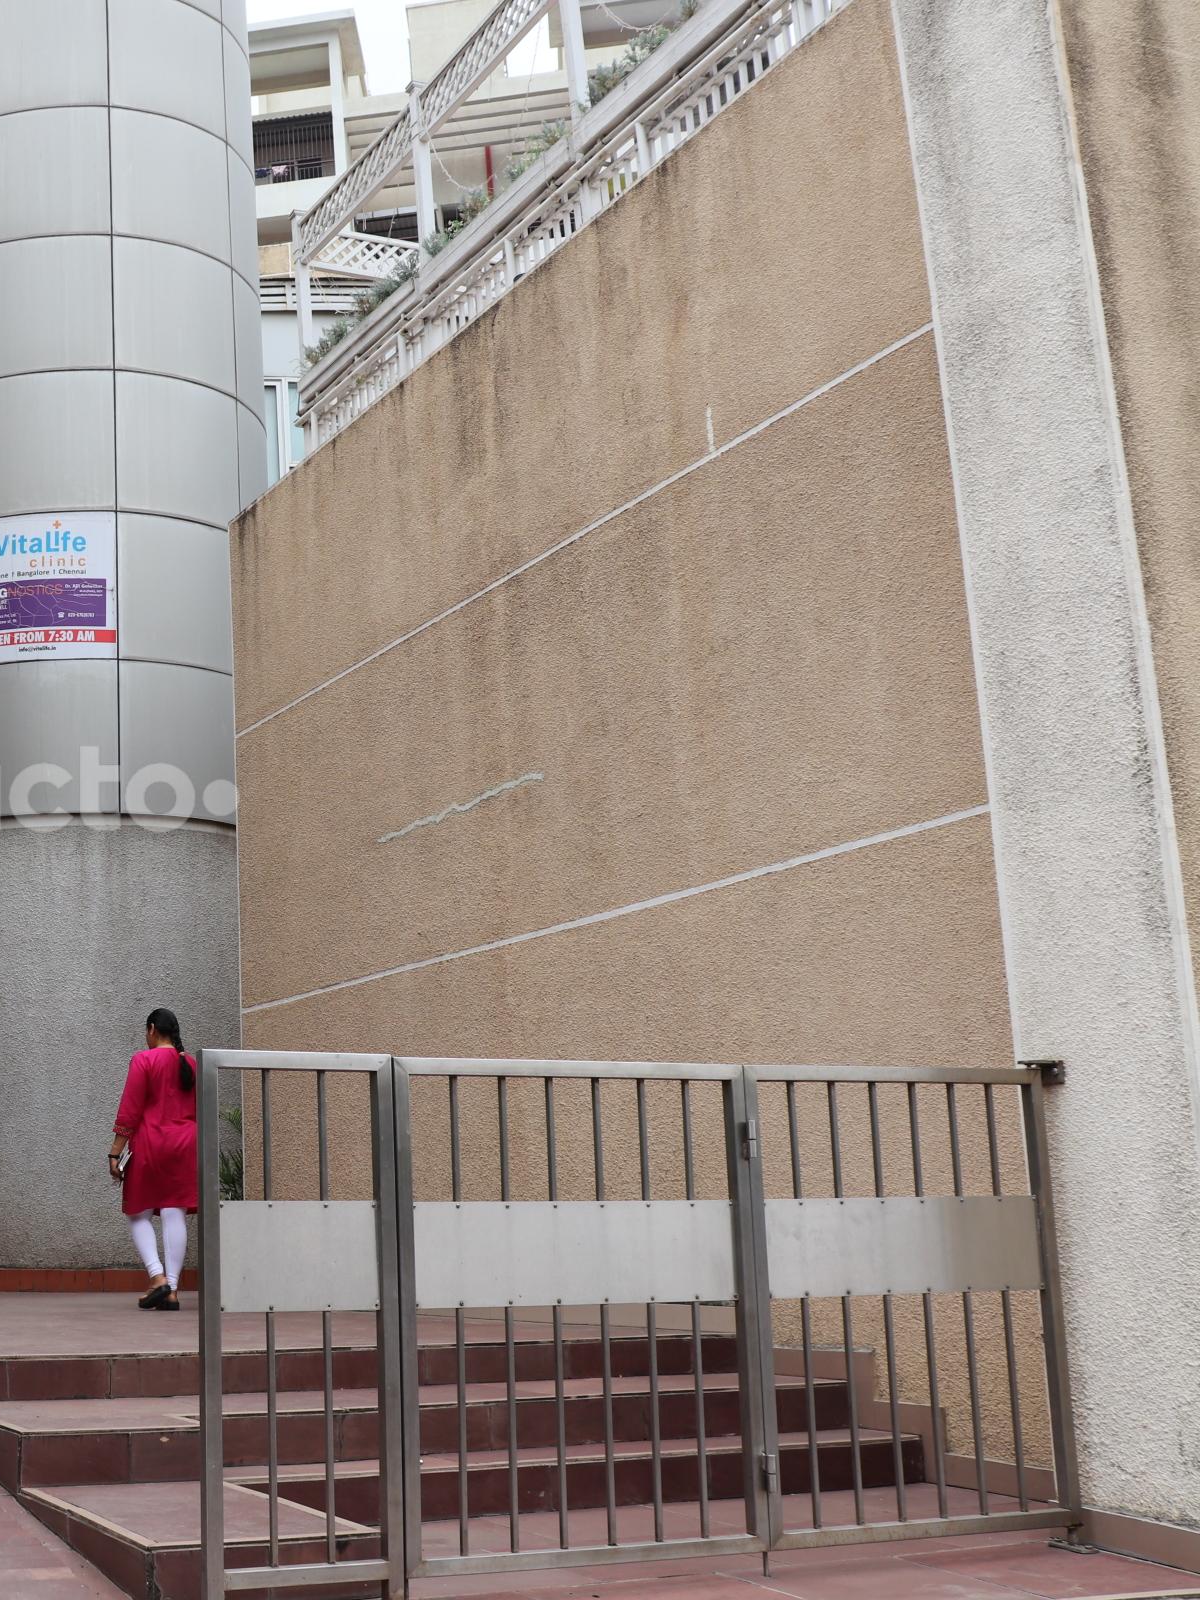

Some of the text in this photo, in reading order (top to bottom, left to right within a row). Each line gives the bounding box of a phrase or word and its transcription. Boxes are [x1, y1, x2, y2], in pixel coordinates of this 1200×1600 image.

[29, 554, 87, 568] clinic
[16, 569, 50, 578] Bangalore
[13, 631, 45, 644] FROM
[48, 630, 74, 642] 7:30
[76, 630, 95, 642] AM
